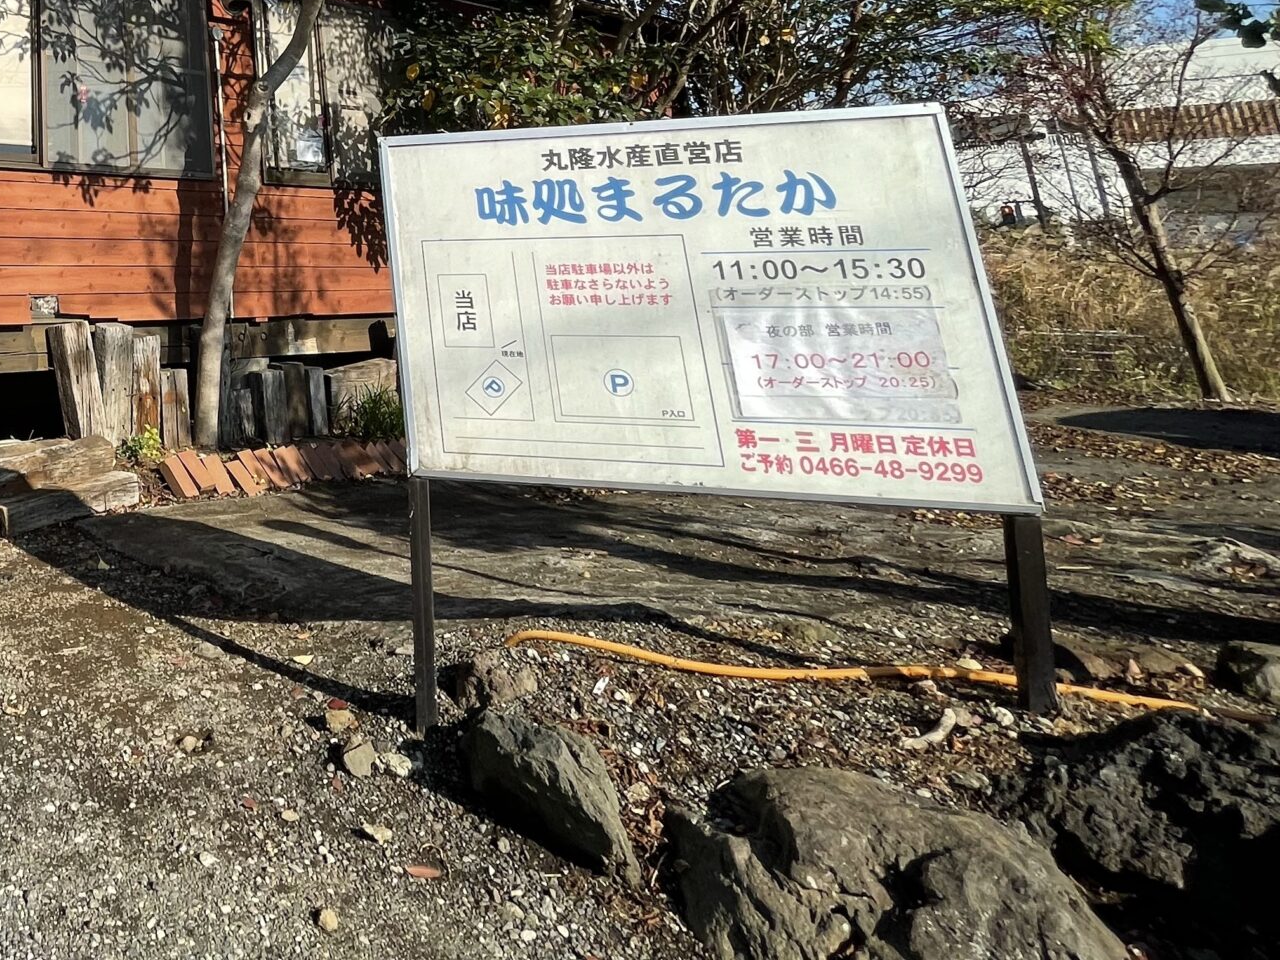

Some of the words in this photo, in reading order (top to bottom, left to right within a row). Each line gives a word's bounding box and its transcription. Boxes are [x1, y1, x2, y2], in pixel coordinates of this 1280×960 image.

[541, 140, 743, 171] 丸隆水産直営店
[475, 169, 837, 226] 味処まるたか
[750, 225, 864, 248] 営業時間
[545, 262, 655, 275] 当店駐車場以外は
[546, 278, 670, 291] 駐車なさらないよう
[455, 290, 477, 331] 当店
[549, 293, 673, 306] お願い申し上げます
[766, 323, 815, 338] 夜の部
[825, 321, 893, 337] 営業時間
[609, 374, 629, 393] P
[830, 432, 897, 455] 月曜日
[901, 435, 977, 458] 定休日
[740, 452, 793, 475] ご予約
[799, 455, 983, 484] 0466-48-9299
